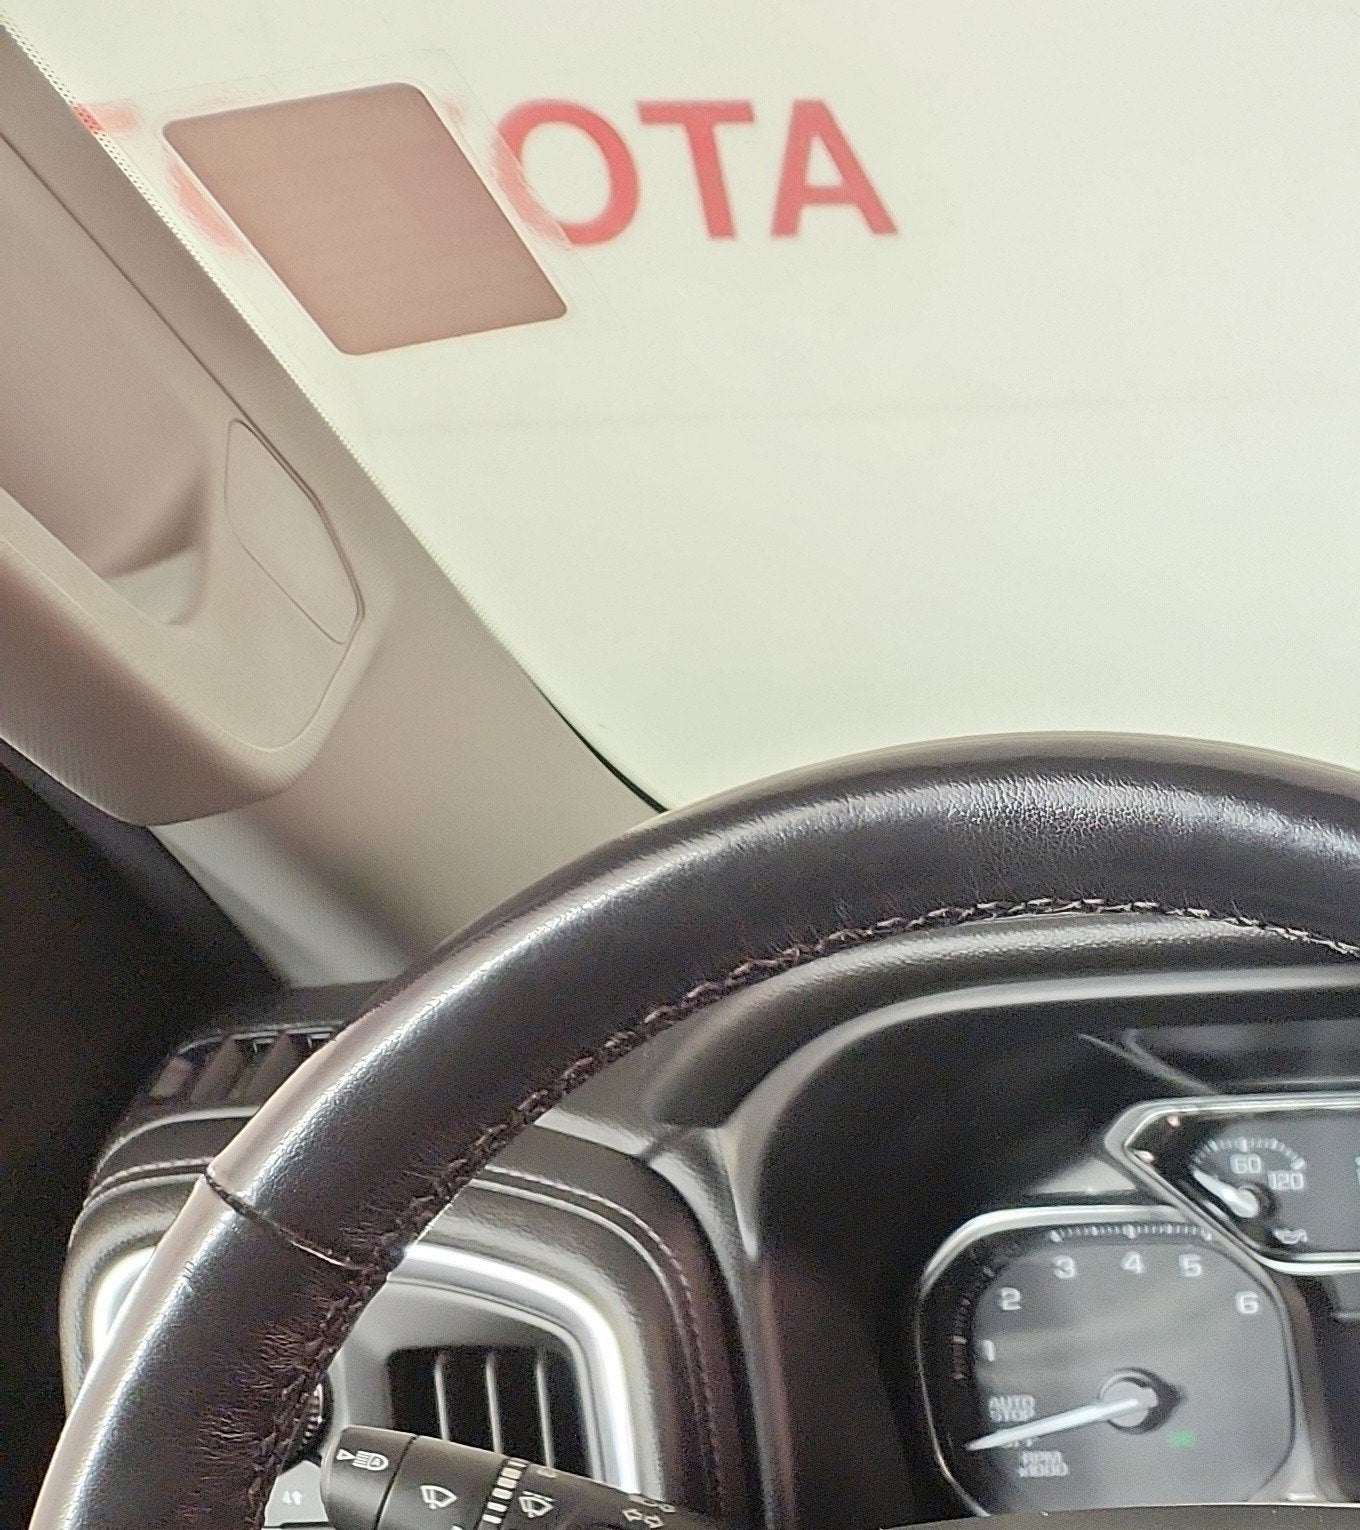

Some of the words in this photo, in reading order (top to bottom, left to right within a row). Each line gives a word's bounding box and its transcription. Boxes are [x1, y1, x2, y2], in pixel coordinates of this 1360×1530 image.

[1229, 1154, 1262, 1175] 60
[1268, 1171, 1305, 1192] 120
[1051, 1255, 1078, 1279] 3
[1122, 1252, 1144, 1275] 4
[1178, 1254, 1203, 1278] 5
[1000, 1287, 1022, 1311] 2
[1235, 1291, 1260, 1315] 6
[981, 1339, 997, 1363] 1
